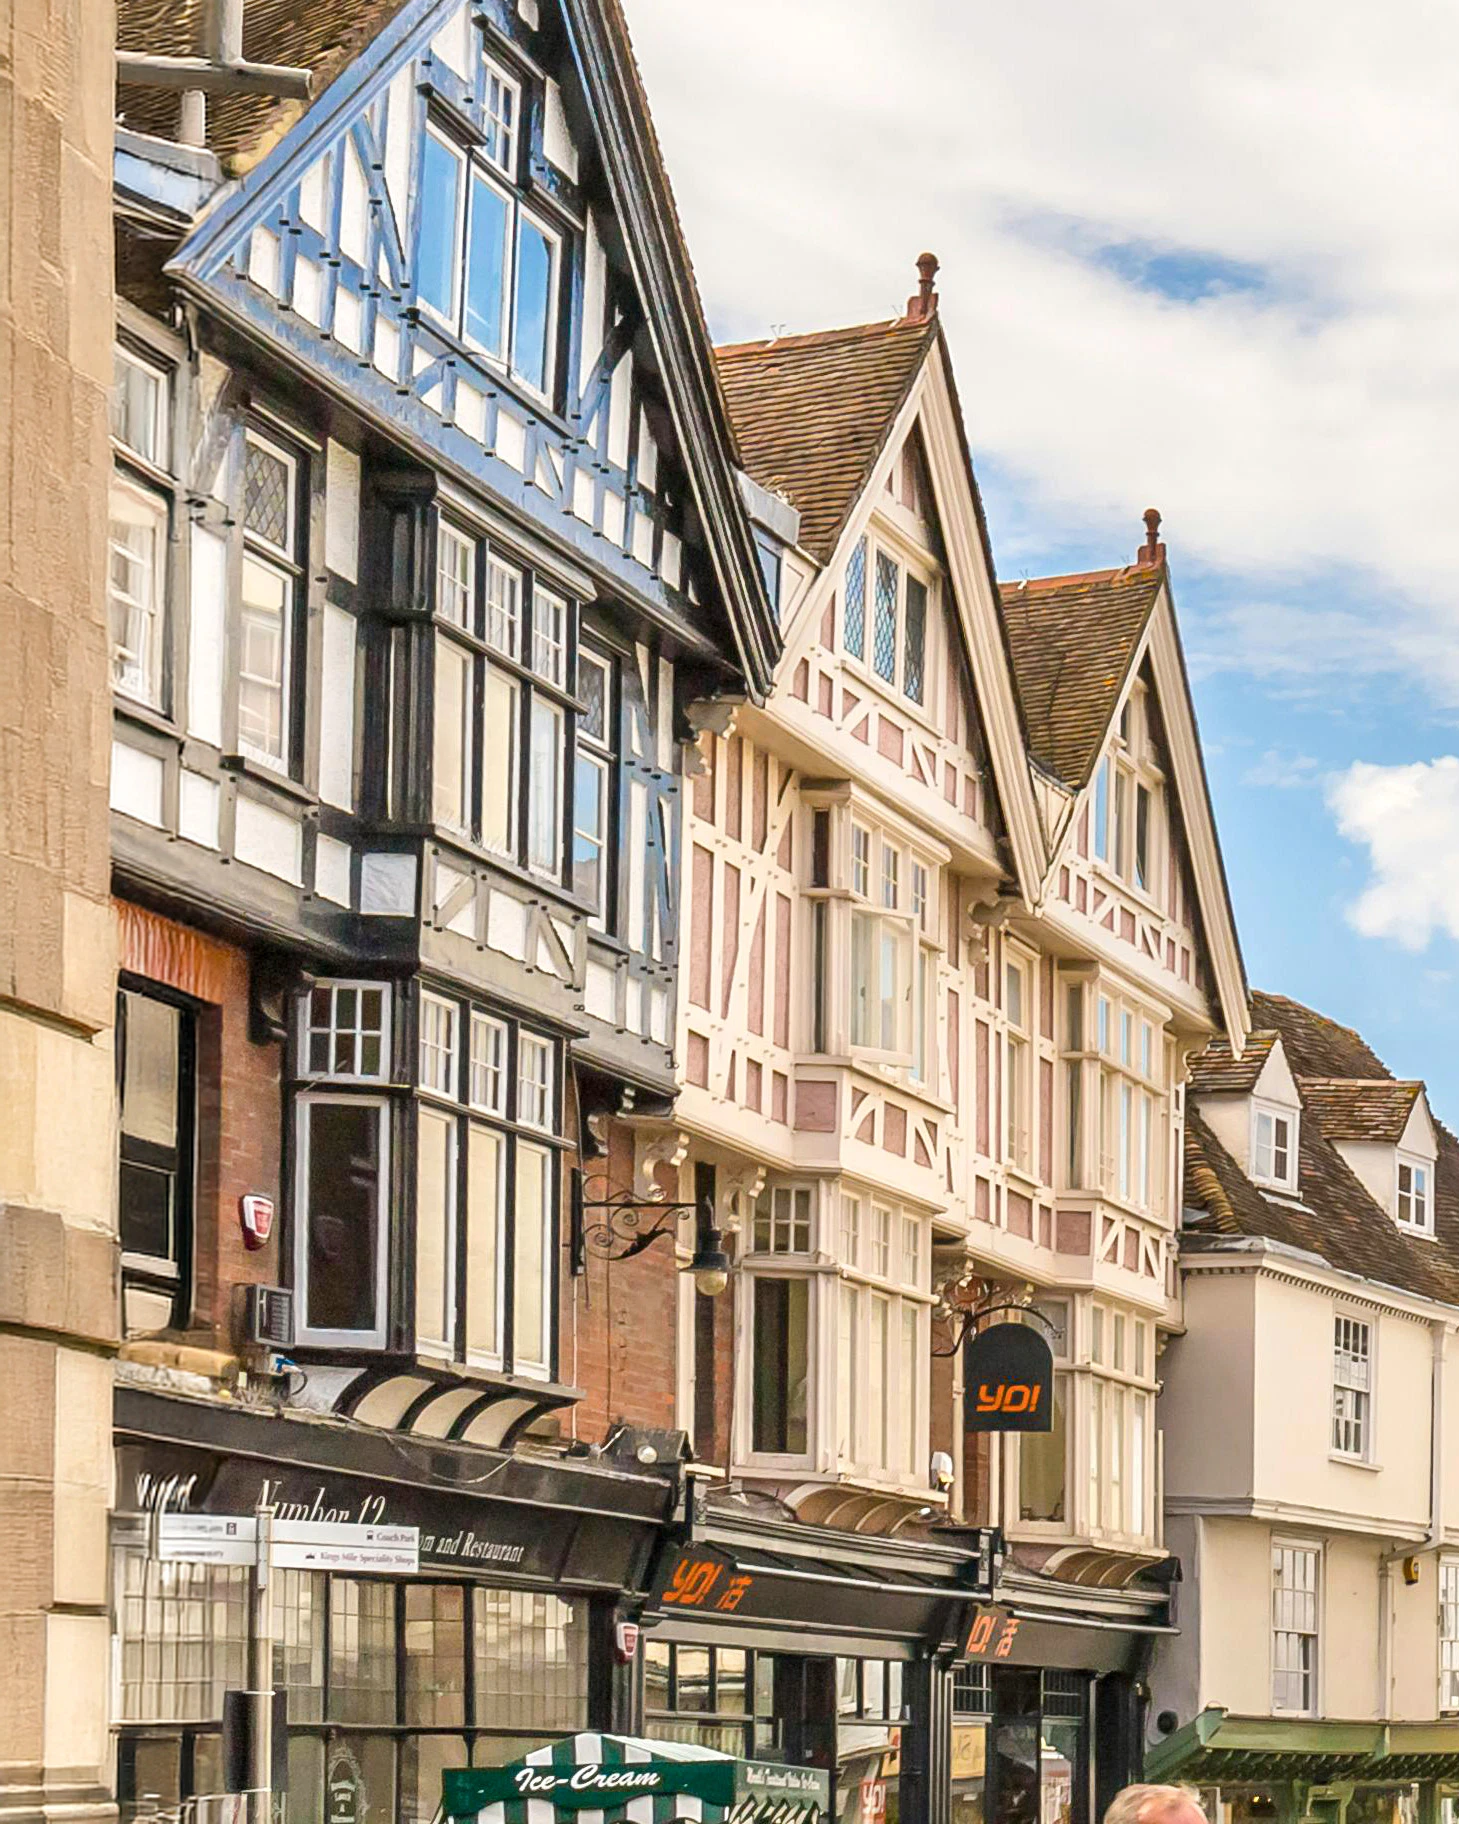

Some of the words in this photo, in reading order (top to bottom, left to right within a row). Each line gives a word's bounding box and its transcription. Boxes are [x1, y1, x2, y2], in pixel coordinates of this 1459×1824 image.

[976, 1384, 1041, 1413] YO!
[436, 1530, 464, 1555] and
[461, 1532, 524, 1563] Restaurant
[662, 1559, 724, 1604] YO!
[514, 1763, 661, 1792] Ice-Cream
